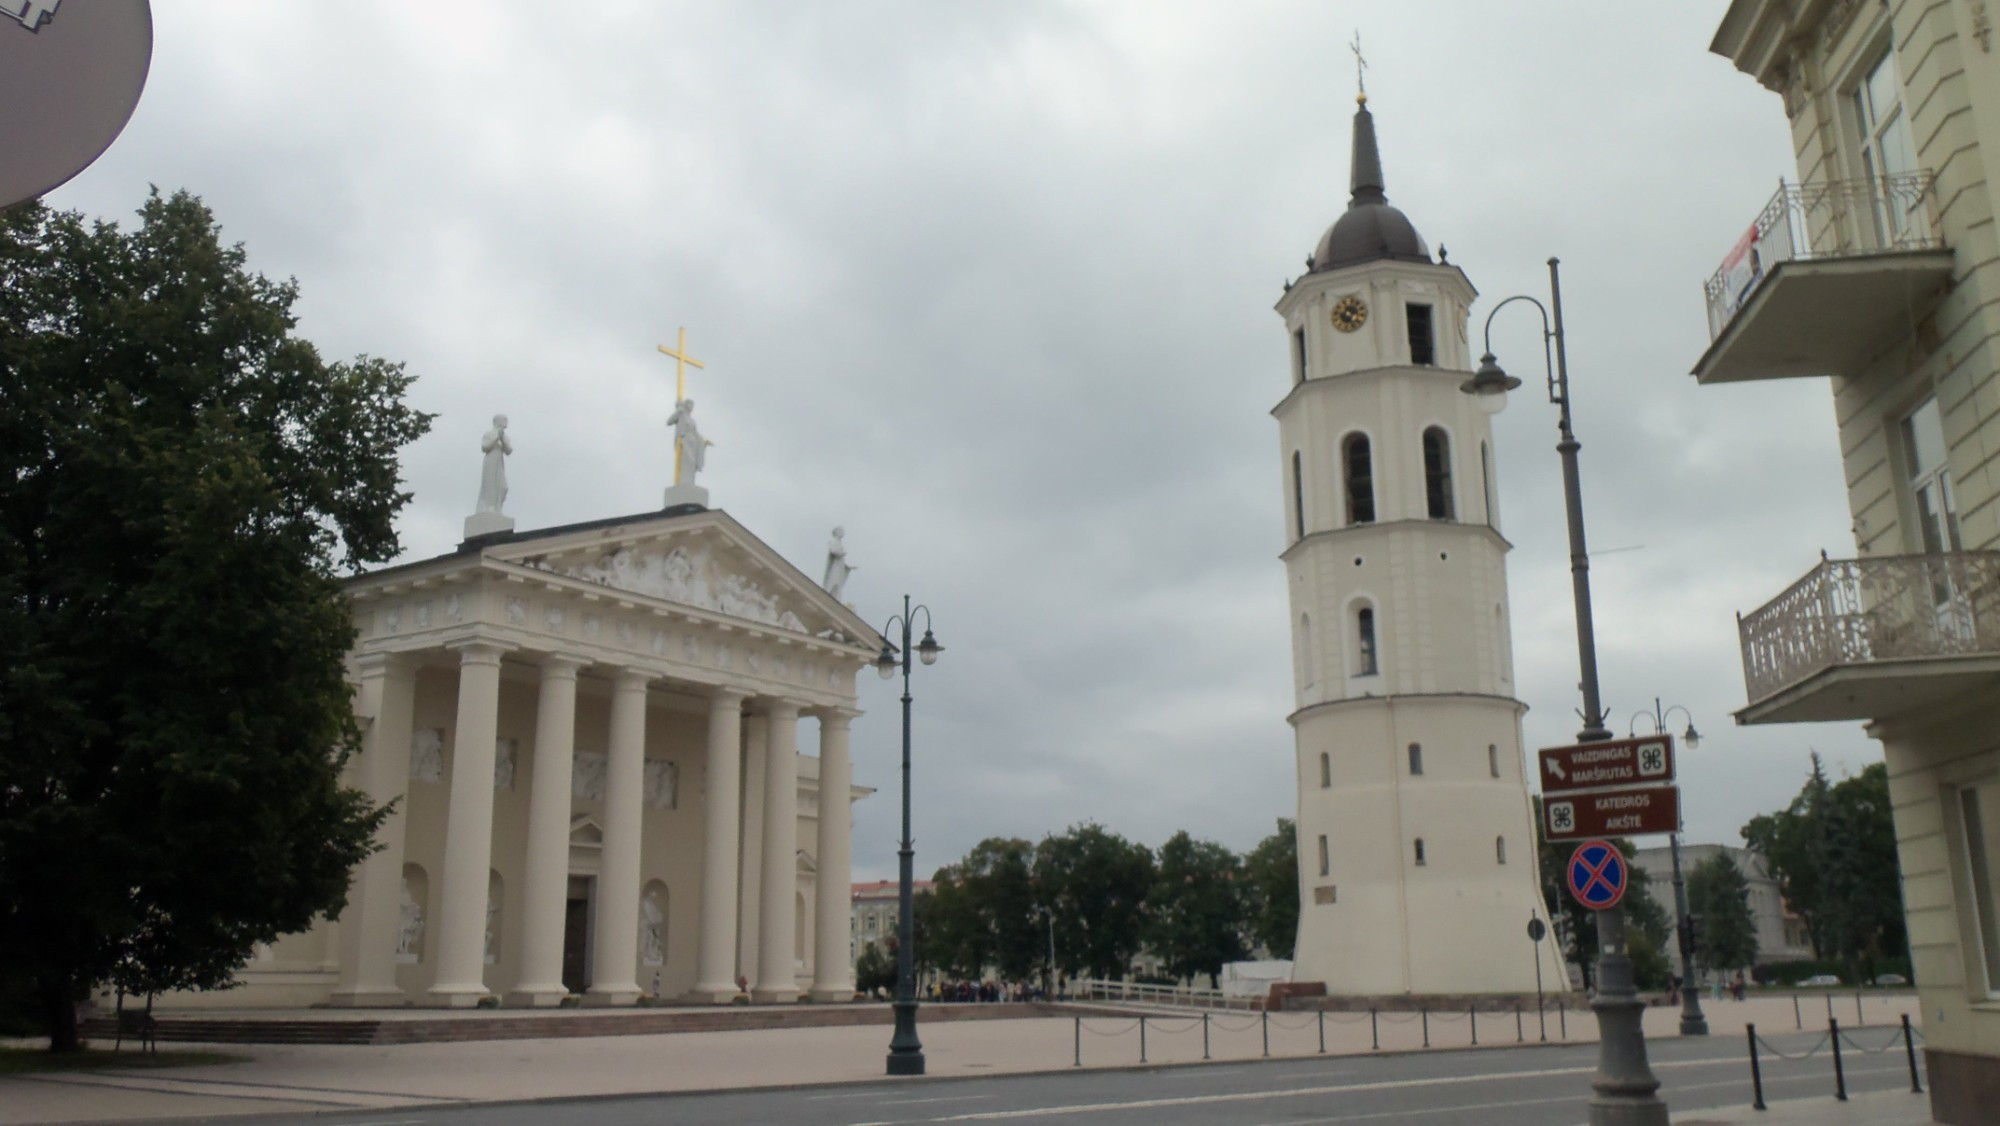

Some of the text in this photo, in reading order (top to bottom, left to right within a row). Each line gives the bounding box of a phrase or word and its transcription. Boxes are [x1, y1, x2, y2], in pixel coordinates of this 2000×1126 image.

[1571, 747, 1631, 763] VAIZDINGAS
[1572, 767, 1633, 782] MARŠRUTAS
[1595, 795, 1650, 810] KATEDROS
